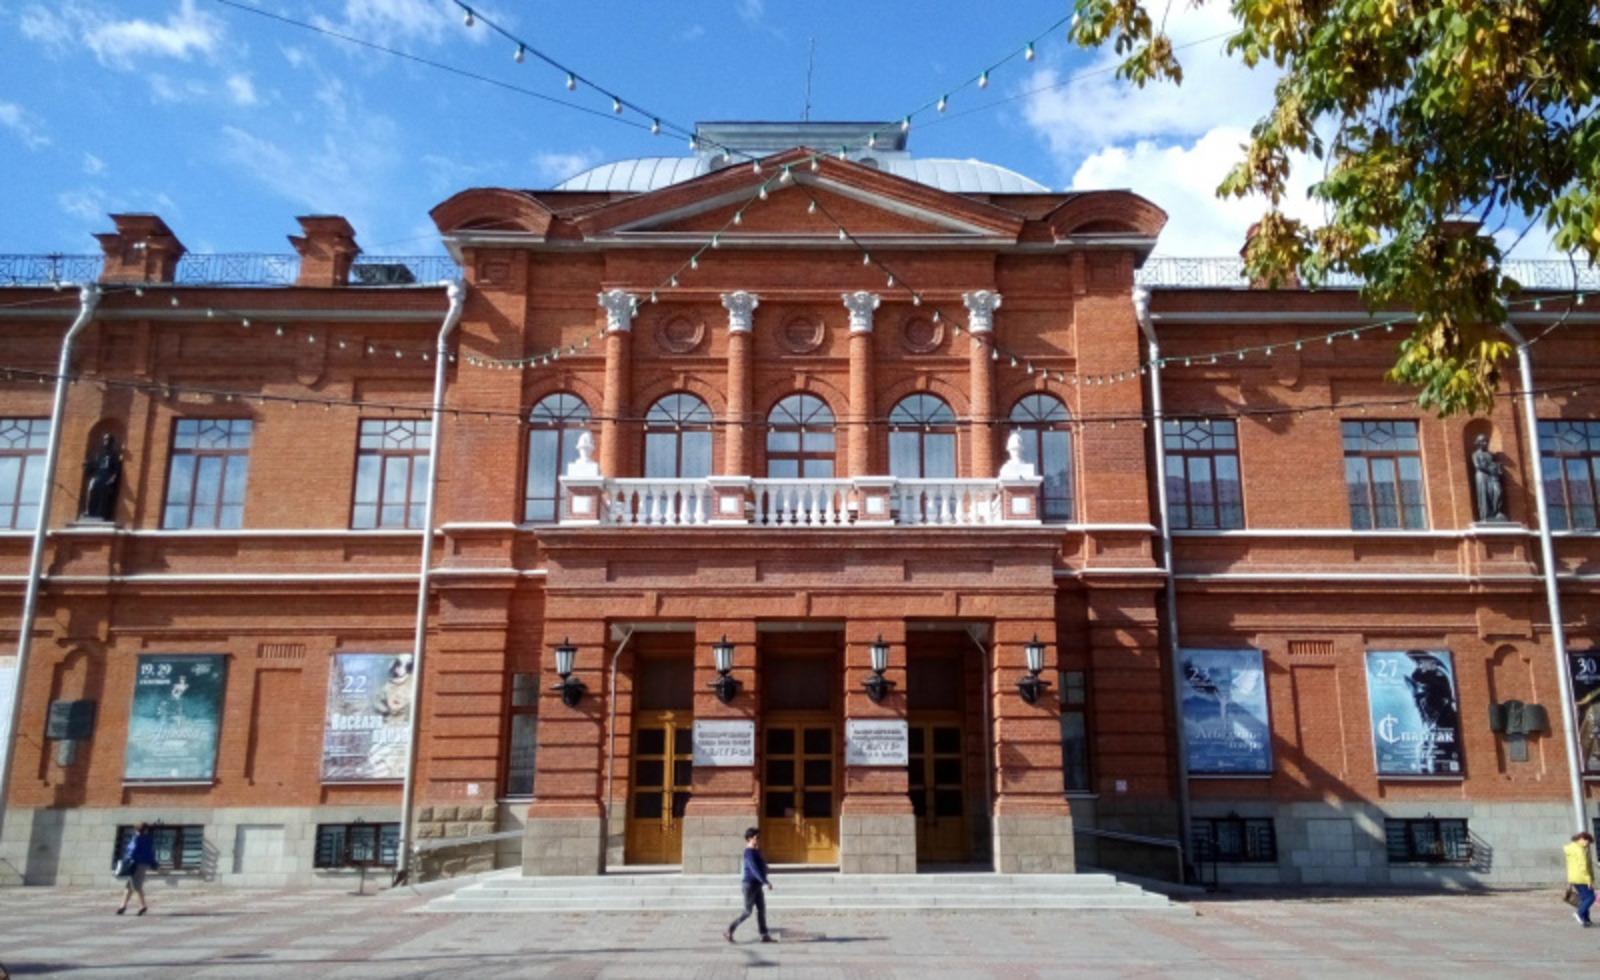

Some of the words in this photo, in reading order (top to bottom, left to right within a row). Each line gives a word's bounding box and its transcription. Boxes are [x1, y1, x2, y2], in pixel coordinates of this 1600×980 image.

[1376, 659, 1399, 677] 27
[1576, 658, 1597, 676] 30
[341, 675, 368, 693] 22
